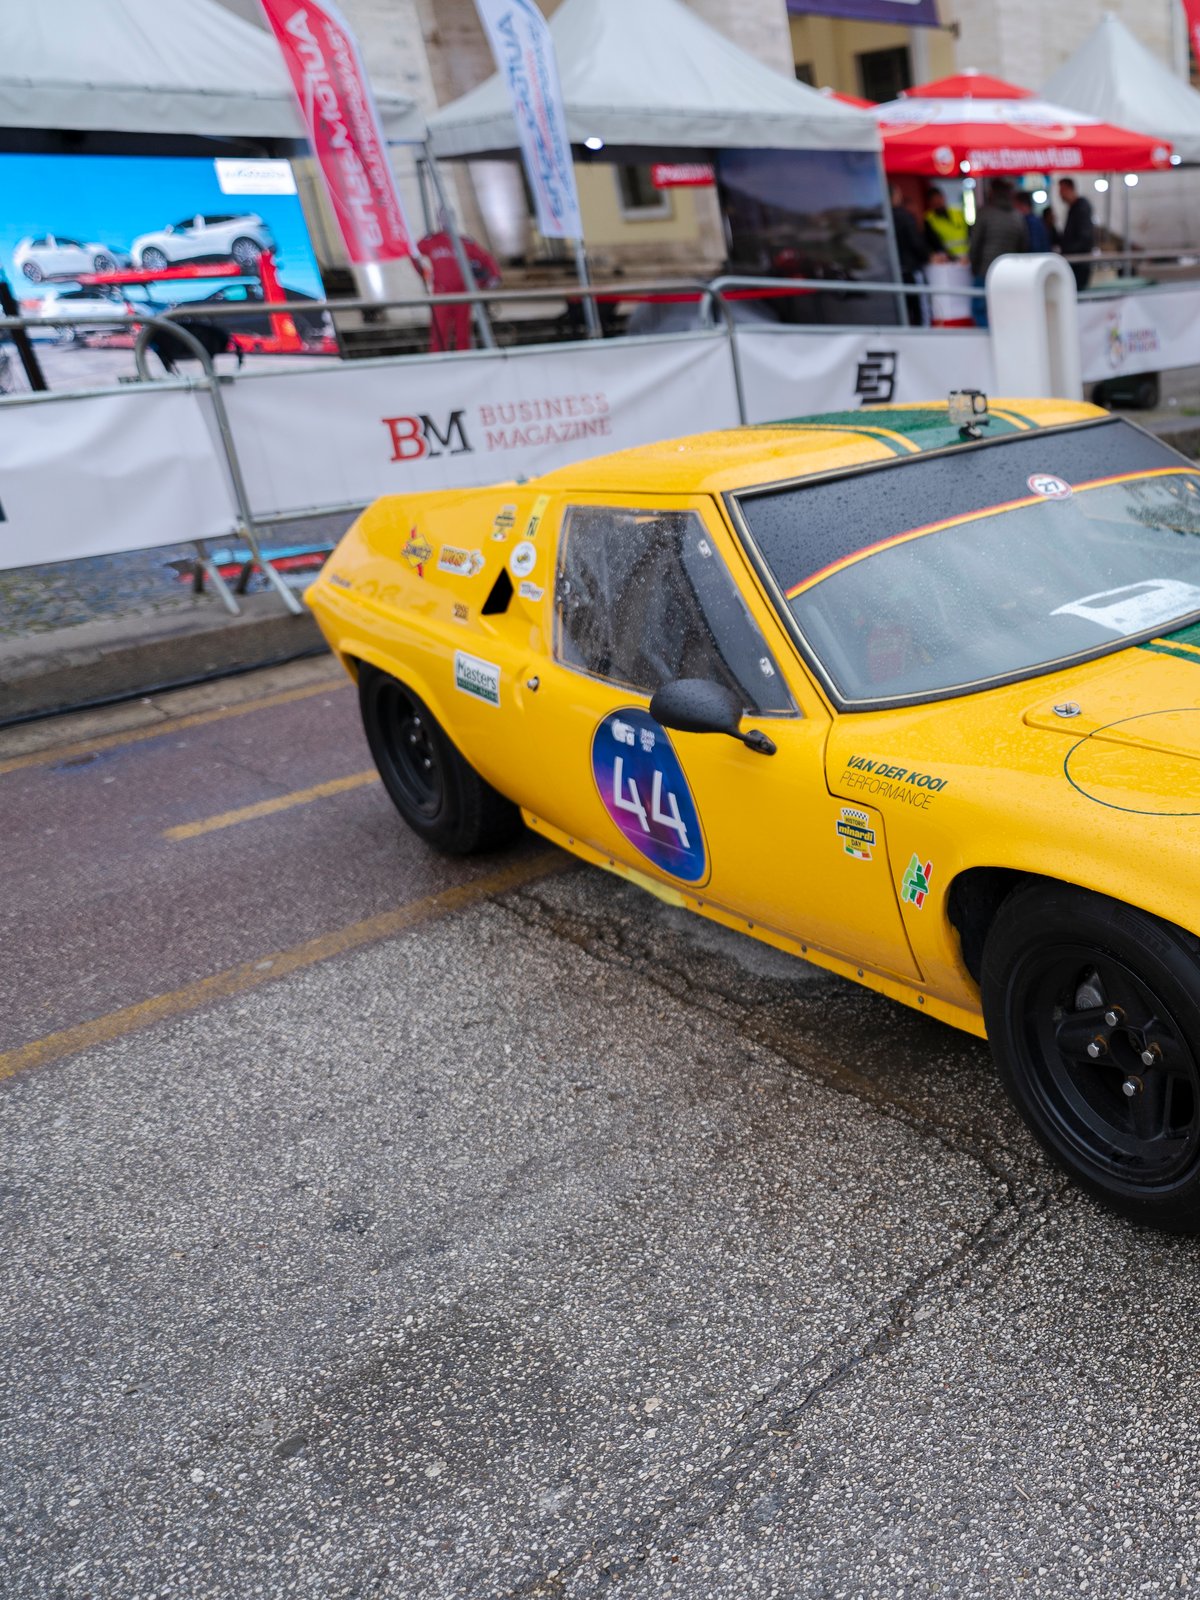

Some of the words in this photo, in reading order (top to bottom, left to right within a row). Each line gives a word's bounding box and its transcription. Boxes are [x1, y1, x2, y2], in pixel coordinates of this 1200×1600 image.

[480, 393, 610, 427] BUSINESS
[382, 410, 473, 462] BM
[486, 416, 613, 451] MAGAZINE
[457, 656, 497, 690] Masters
[840, 771, 935, 810] PERFORMANCE
[847, 755, 878, 772] VAN
[875, 763, 908, 781] DER
[905, 772, 948, 792] KOOI
[613, 756, 691, 848] 44
[838, 825, 873, 842] minardi
[845, 817, 866, 828] HISTORIC
